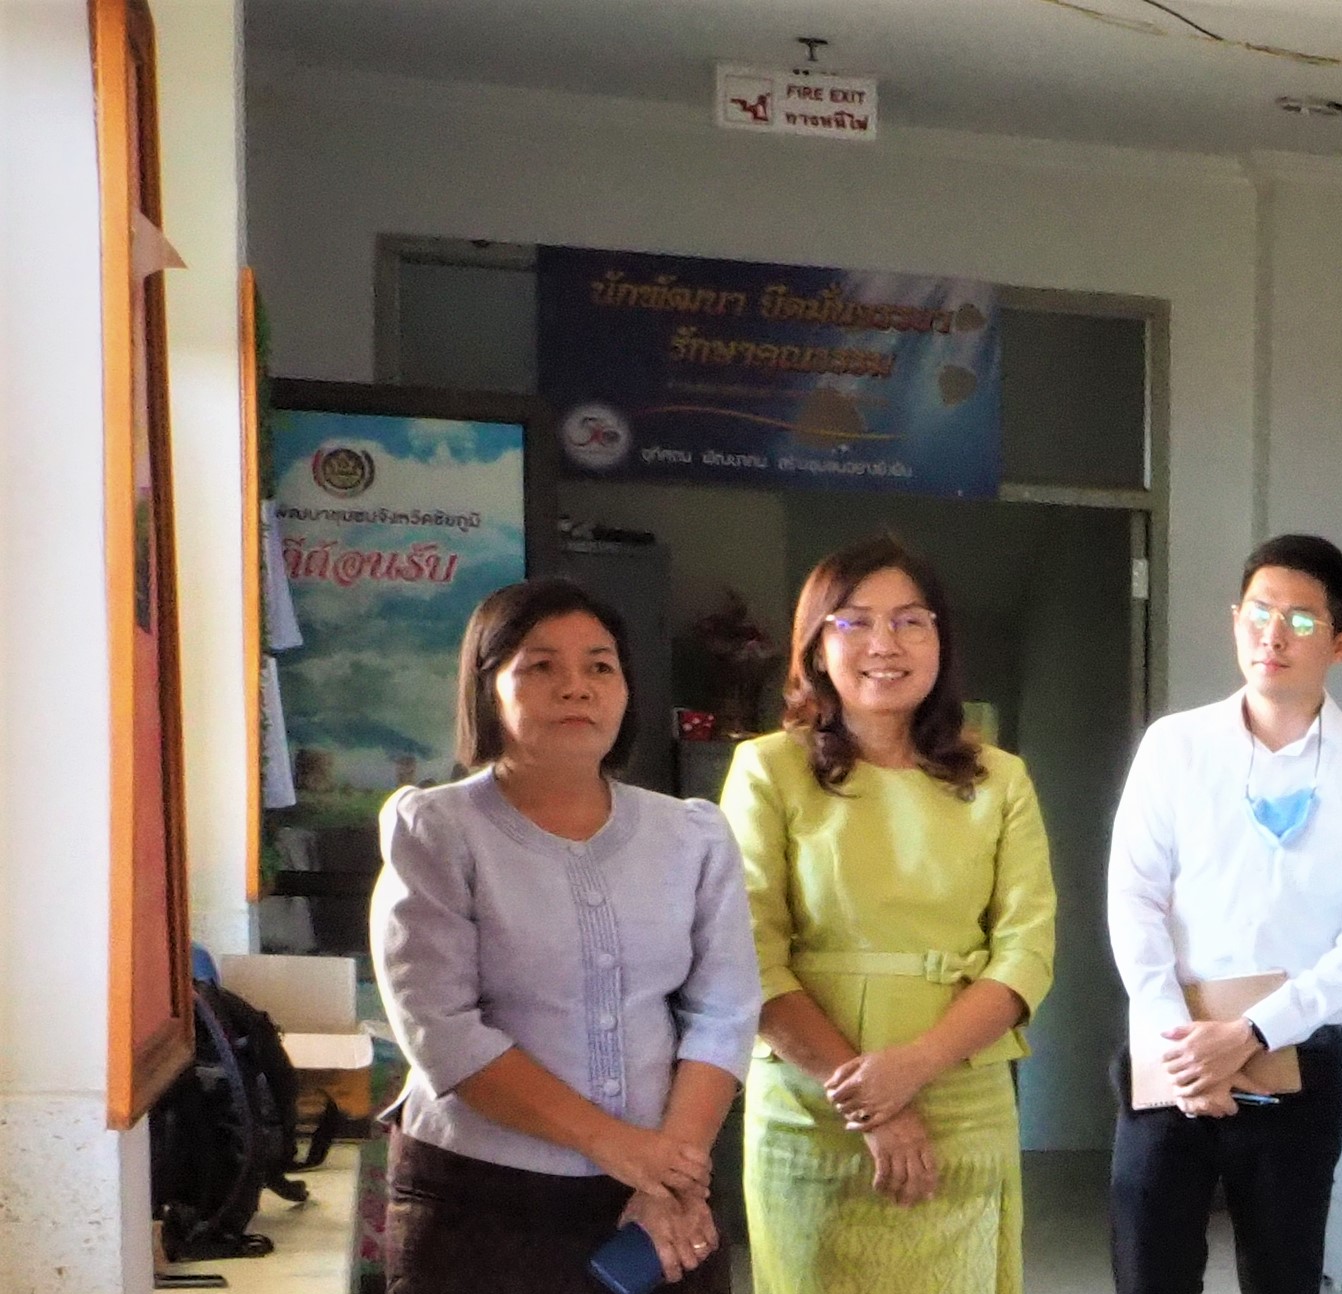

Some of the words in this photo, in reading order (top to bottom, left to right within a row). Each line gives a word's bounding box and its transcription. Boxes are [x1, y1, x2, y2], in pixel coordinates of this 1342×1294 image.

[786, 84, 824, 102] FIRE
[829, 87, 866, 104] EXIT
[283, 537, 458, 588] ดีต้อนรับ
